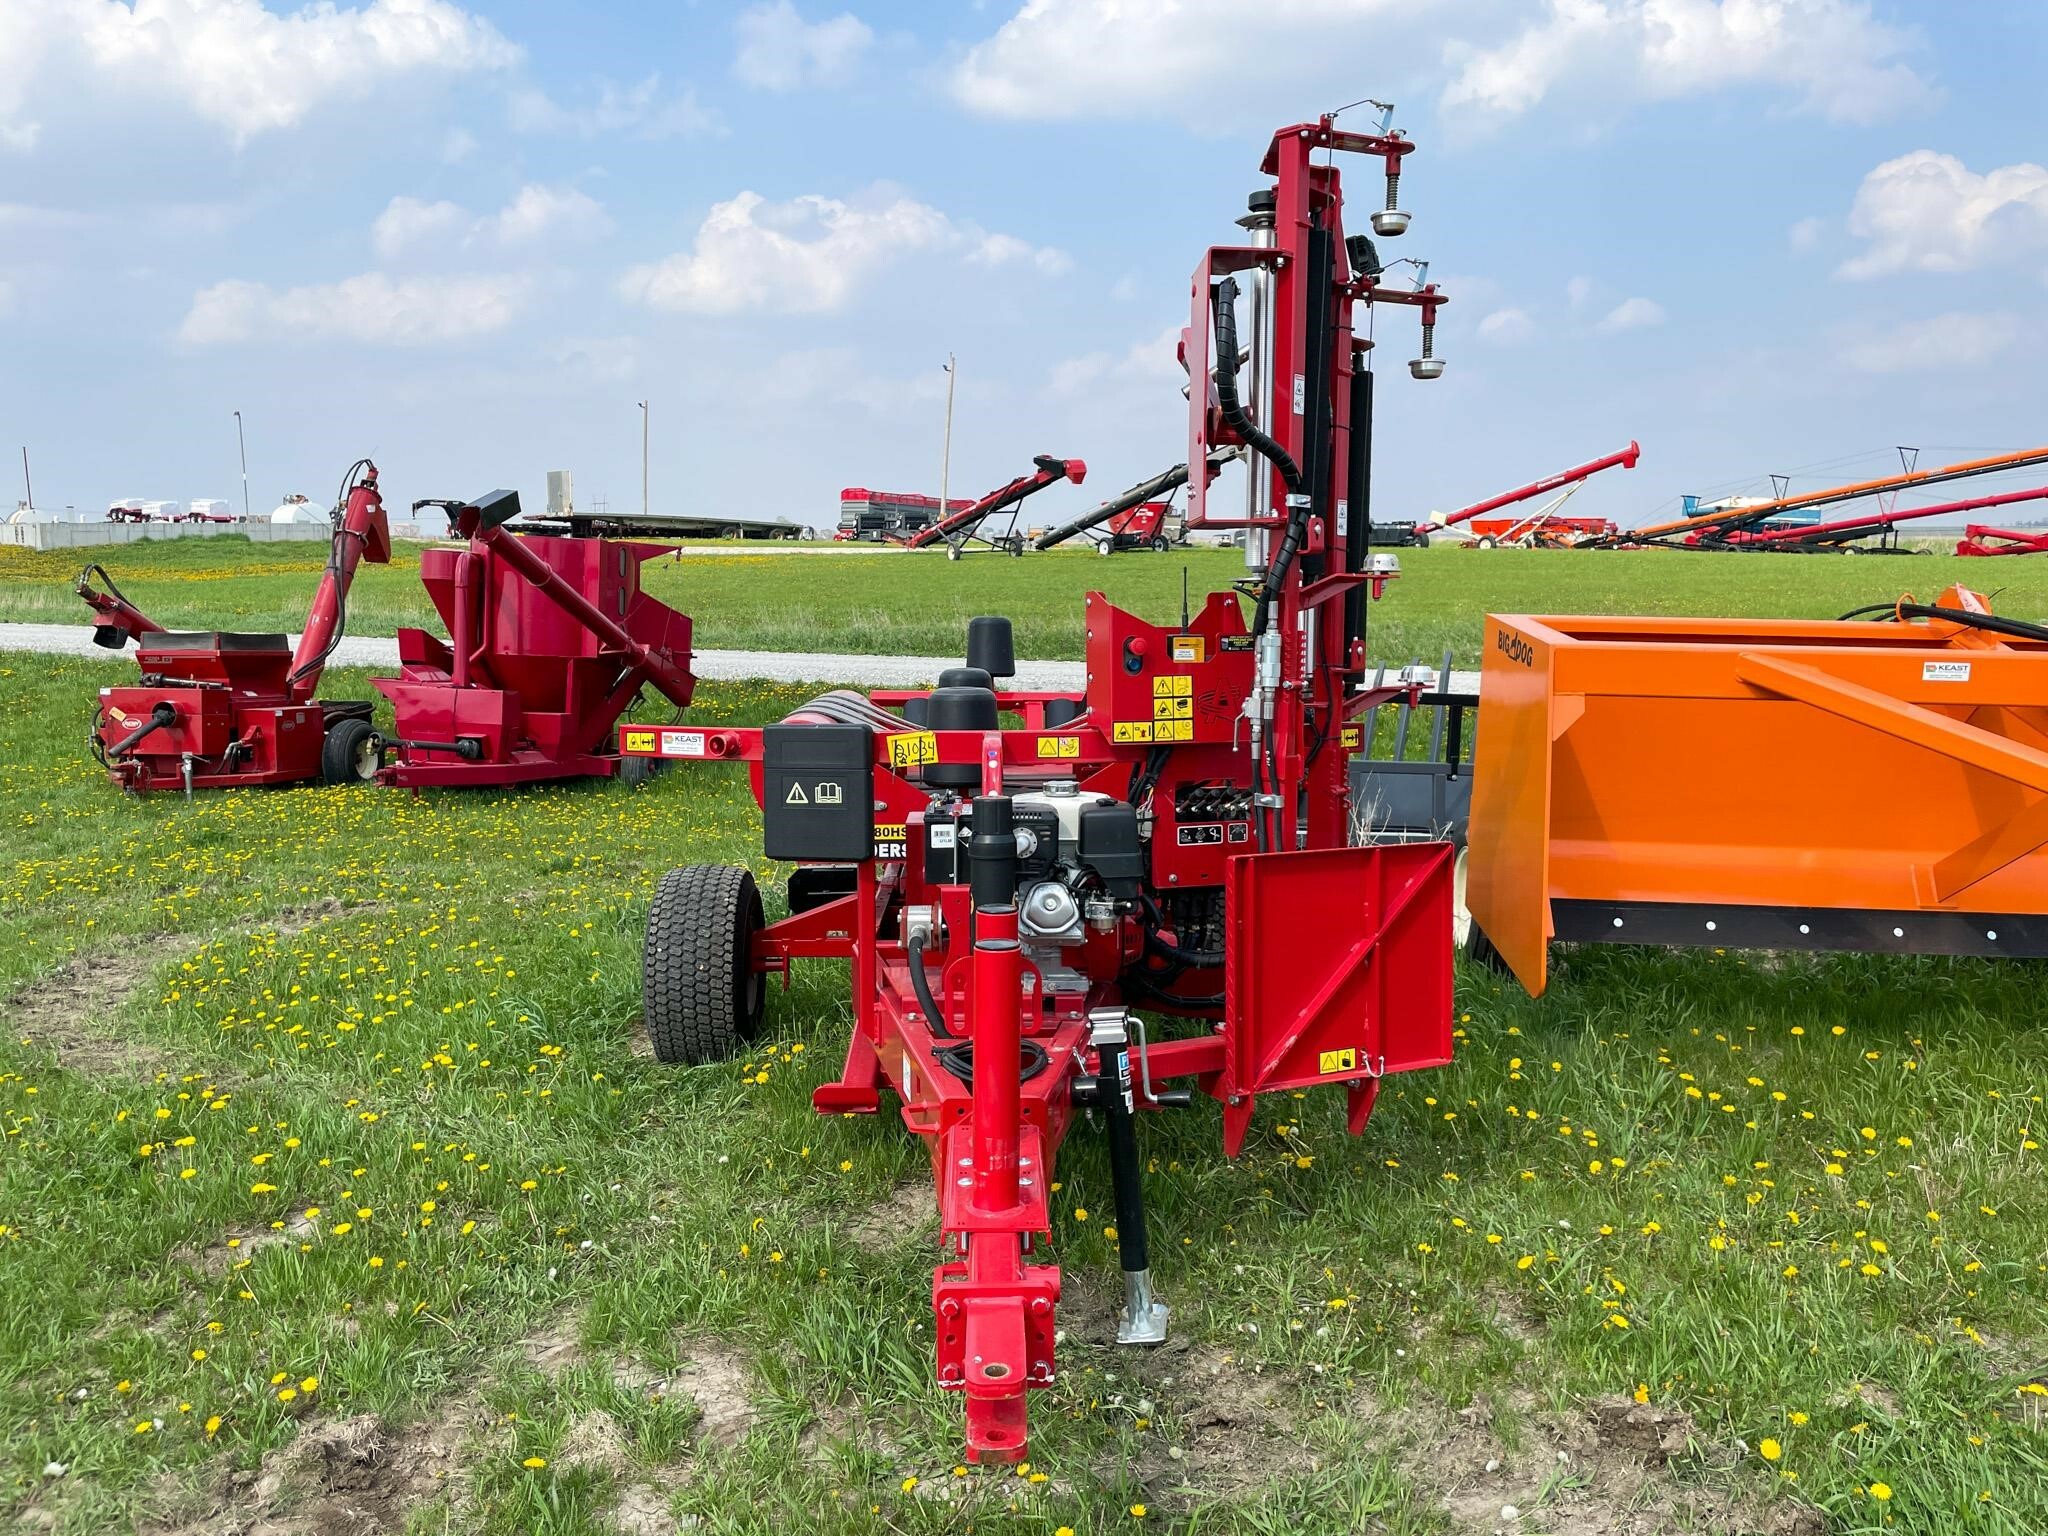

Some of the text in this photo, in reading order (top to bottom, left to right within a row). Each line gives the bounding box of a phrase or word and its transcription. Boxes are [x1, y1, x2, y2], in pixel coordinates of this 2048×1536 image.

[1498, 629, 1533, 667] BIG DOG
[674, 735, 702, 743] KEAST
